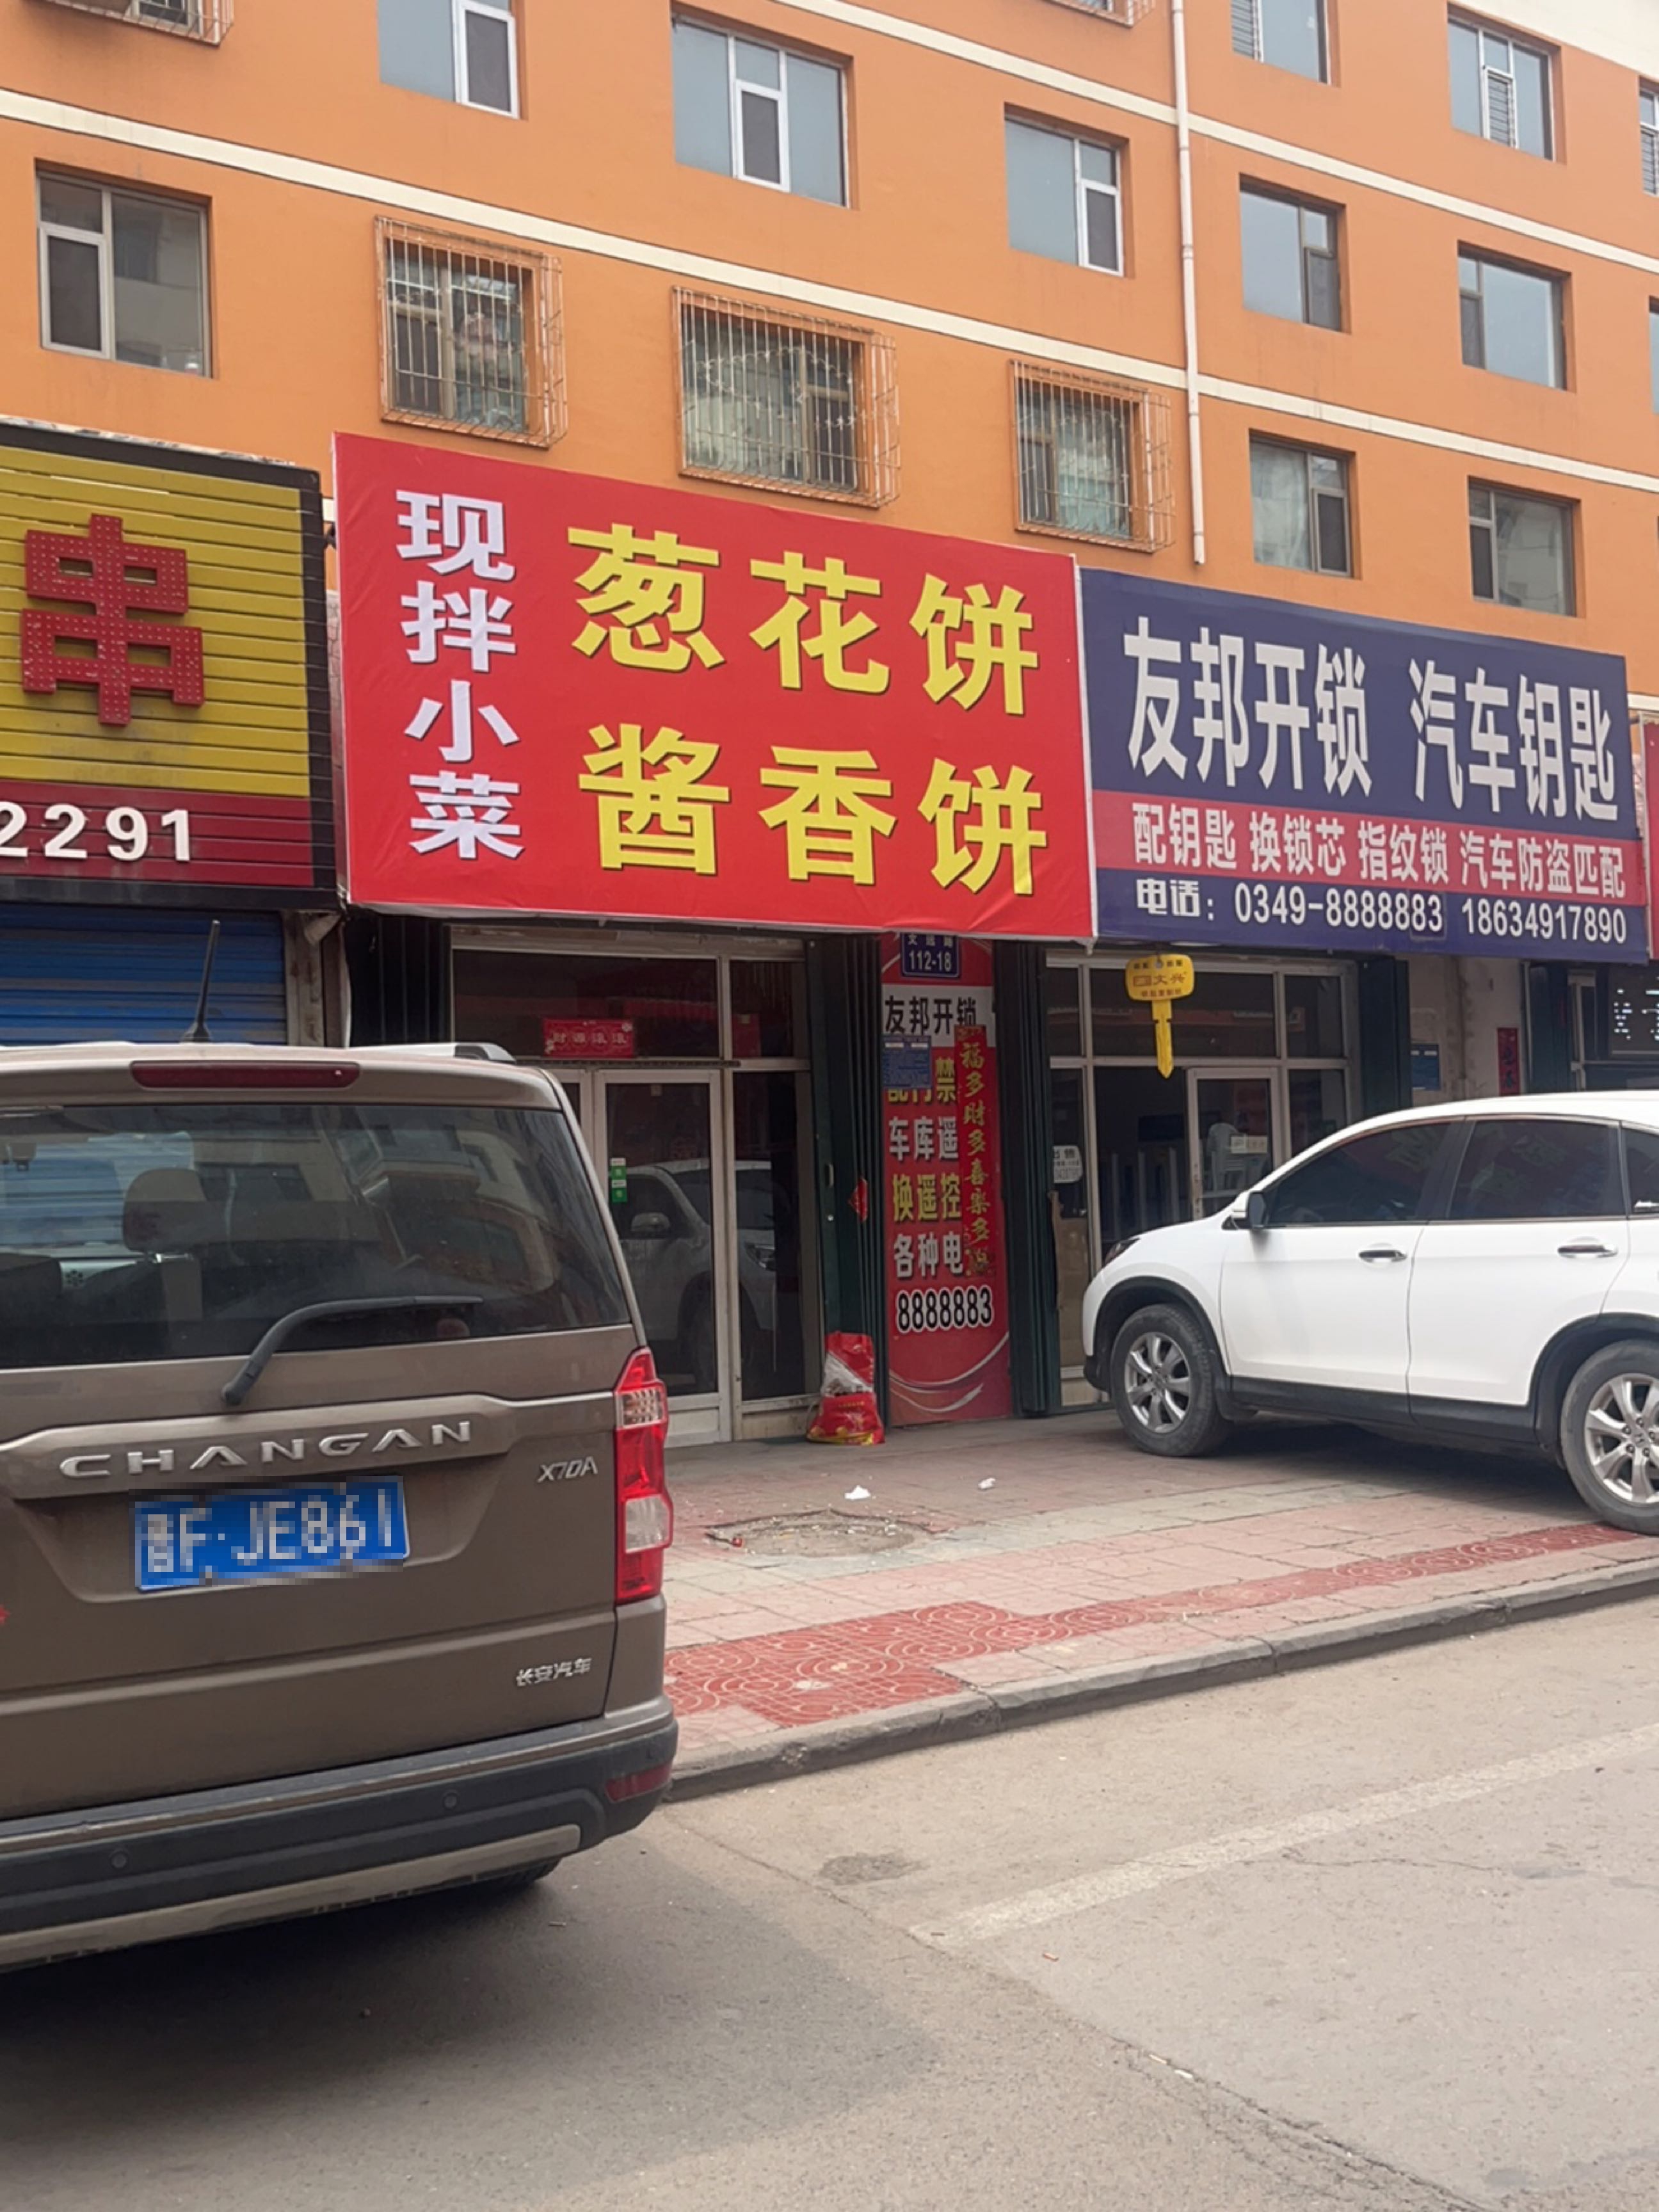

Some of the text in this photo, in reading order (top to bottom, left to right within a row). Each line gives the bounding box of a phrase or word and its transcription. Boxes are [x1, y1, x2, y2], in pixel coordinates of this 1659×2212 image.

[22, 513, 205, 726] 串
[568, 523, 1038, 715] 葱花饼
[396, 489, 524, 860] 现拌小菜
[1124, 616, 1619, 822] 友邦开锁 汽车钥匙
[579, 723, 1047, 895] 酱香饼
[1132, 802, 1626, 899] 配钥匙 换锁芯 指纹锁 汽车防盗匹配
[1235, 882, 1443, 933] 0349-8888883
[1462, 899, 1626, 945] 18634917890
[909, 949, 952, 972] 112-18
[885, 995, 977, 1035] 友邦开锁
[897, 1285, 993, 1332] 8888883
[59, 1420, 472, 1479] CHANGAN
[536, 1455, 599, 1483] X70A
[515, 1656, 593, 1687] 长安汽车
